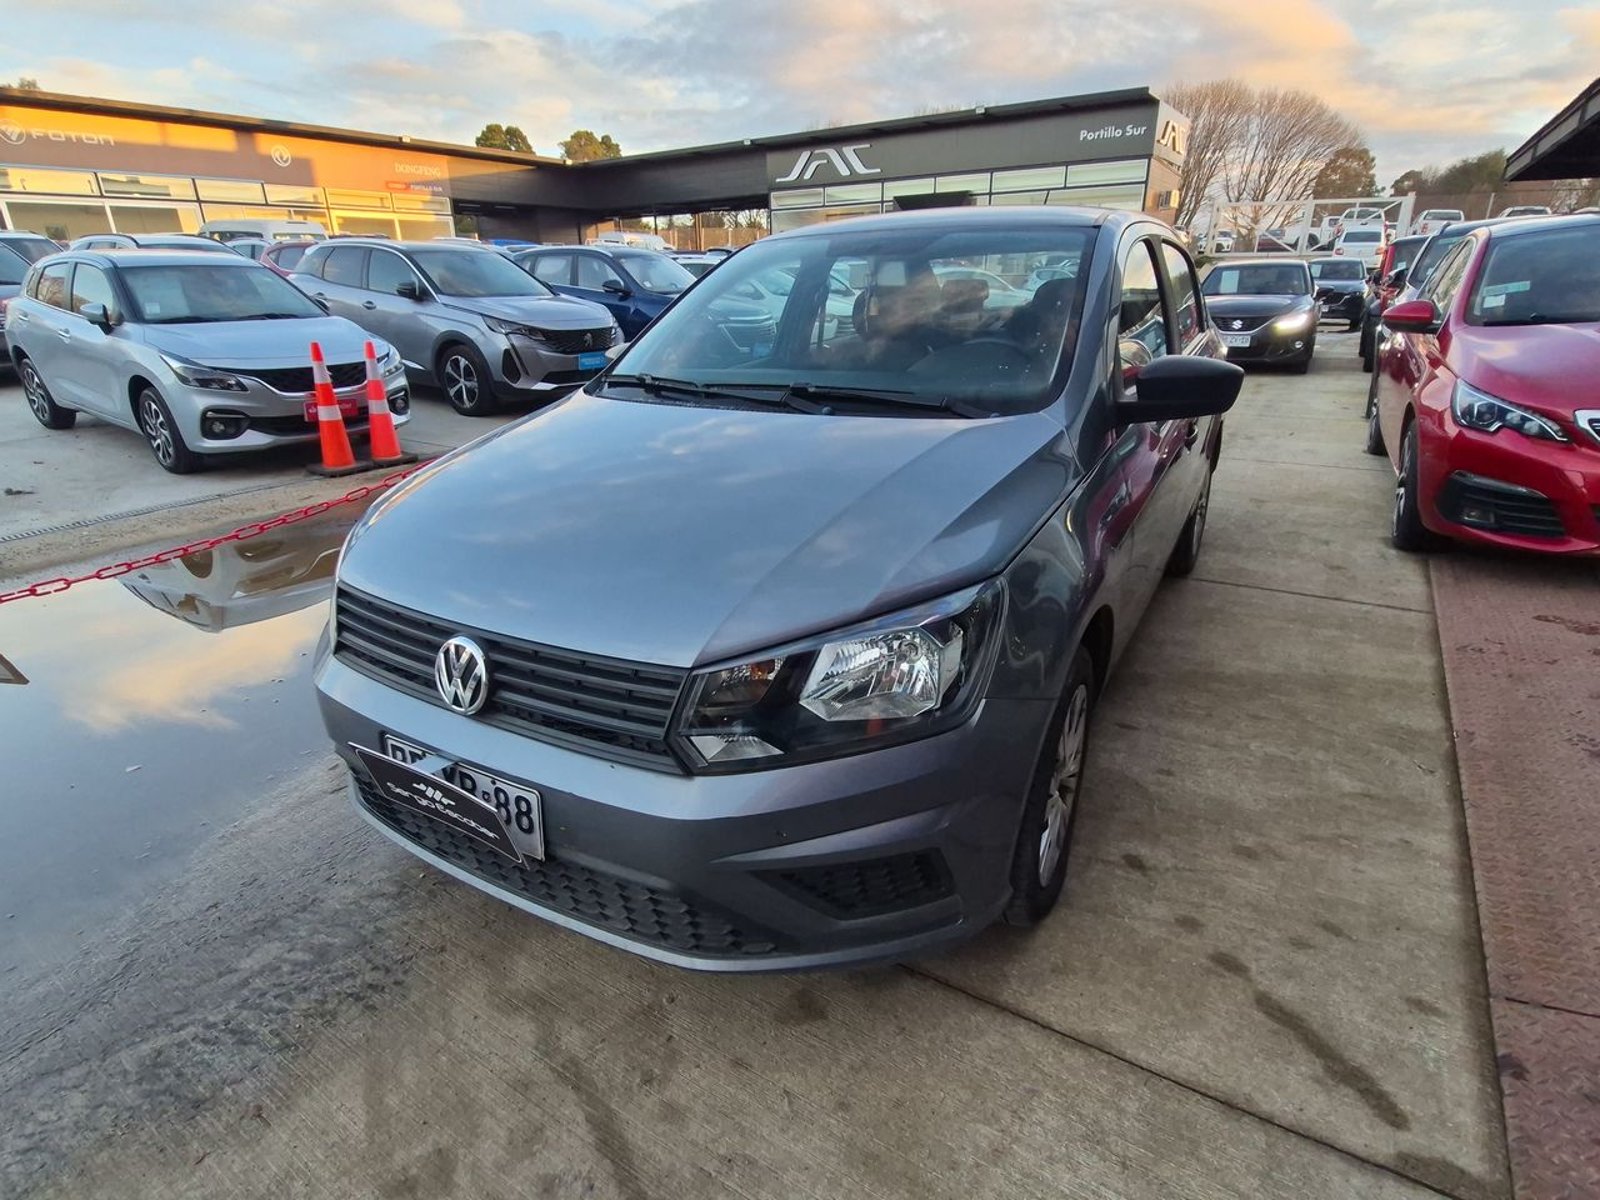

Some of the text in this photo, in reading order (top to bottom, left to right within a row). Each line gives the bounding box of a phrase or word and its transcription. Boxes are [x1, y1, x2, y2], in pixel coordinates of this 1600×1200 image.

[1079, 124, 1147, 141] Portillo Sur
[775, 143, 882, 183] JAC
